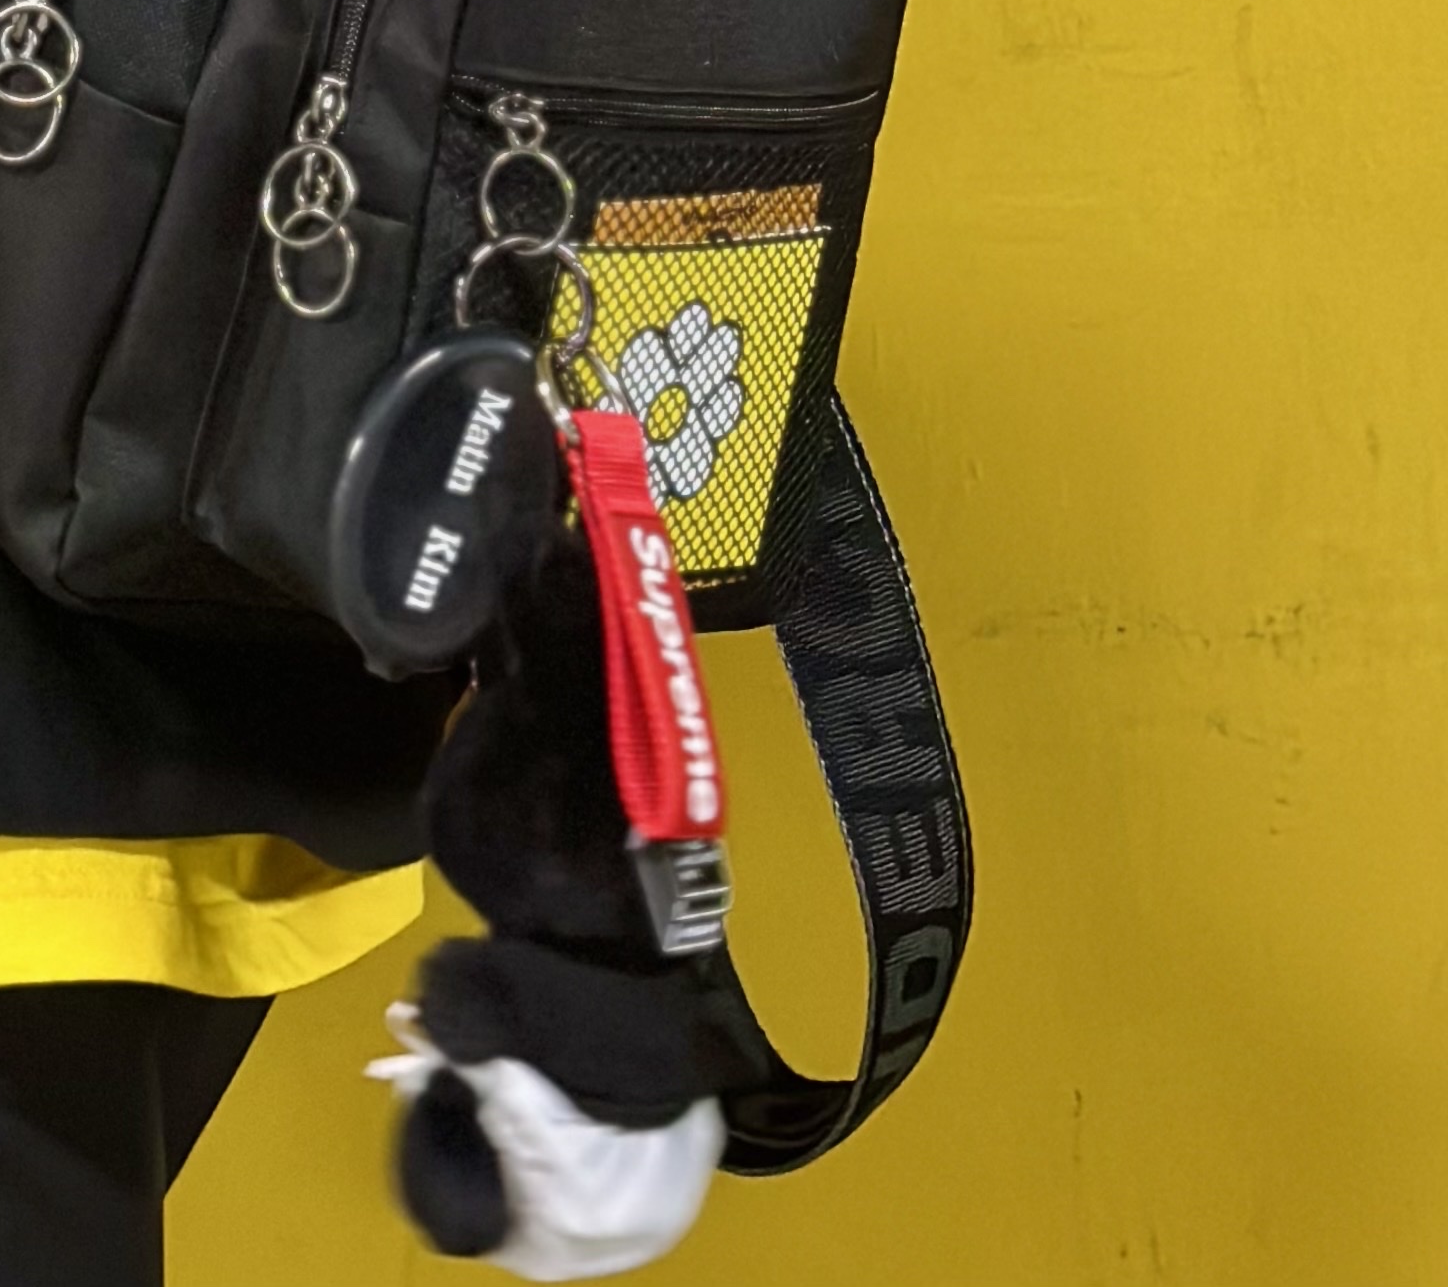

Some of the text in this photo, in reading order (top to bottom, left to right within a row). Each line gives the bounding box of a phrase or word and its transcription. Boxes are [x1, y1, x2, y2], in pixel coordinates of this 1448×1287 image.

[405, 387, 513, 612] Matin Kim
[629, 526, 720, 824] Supreme
